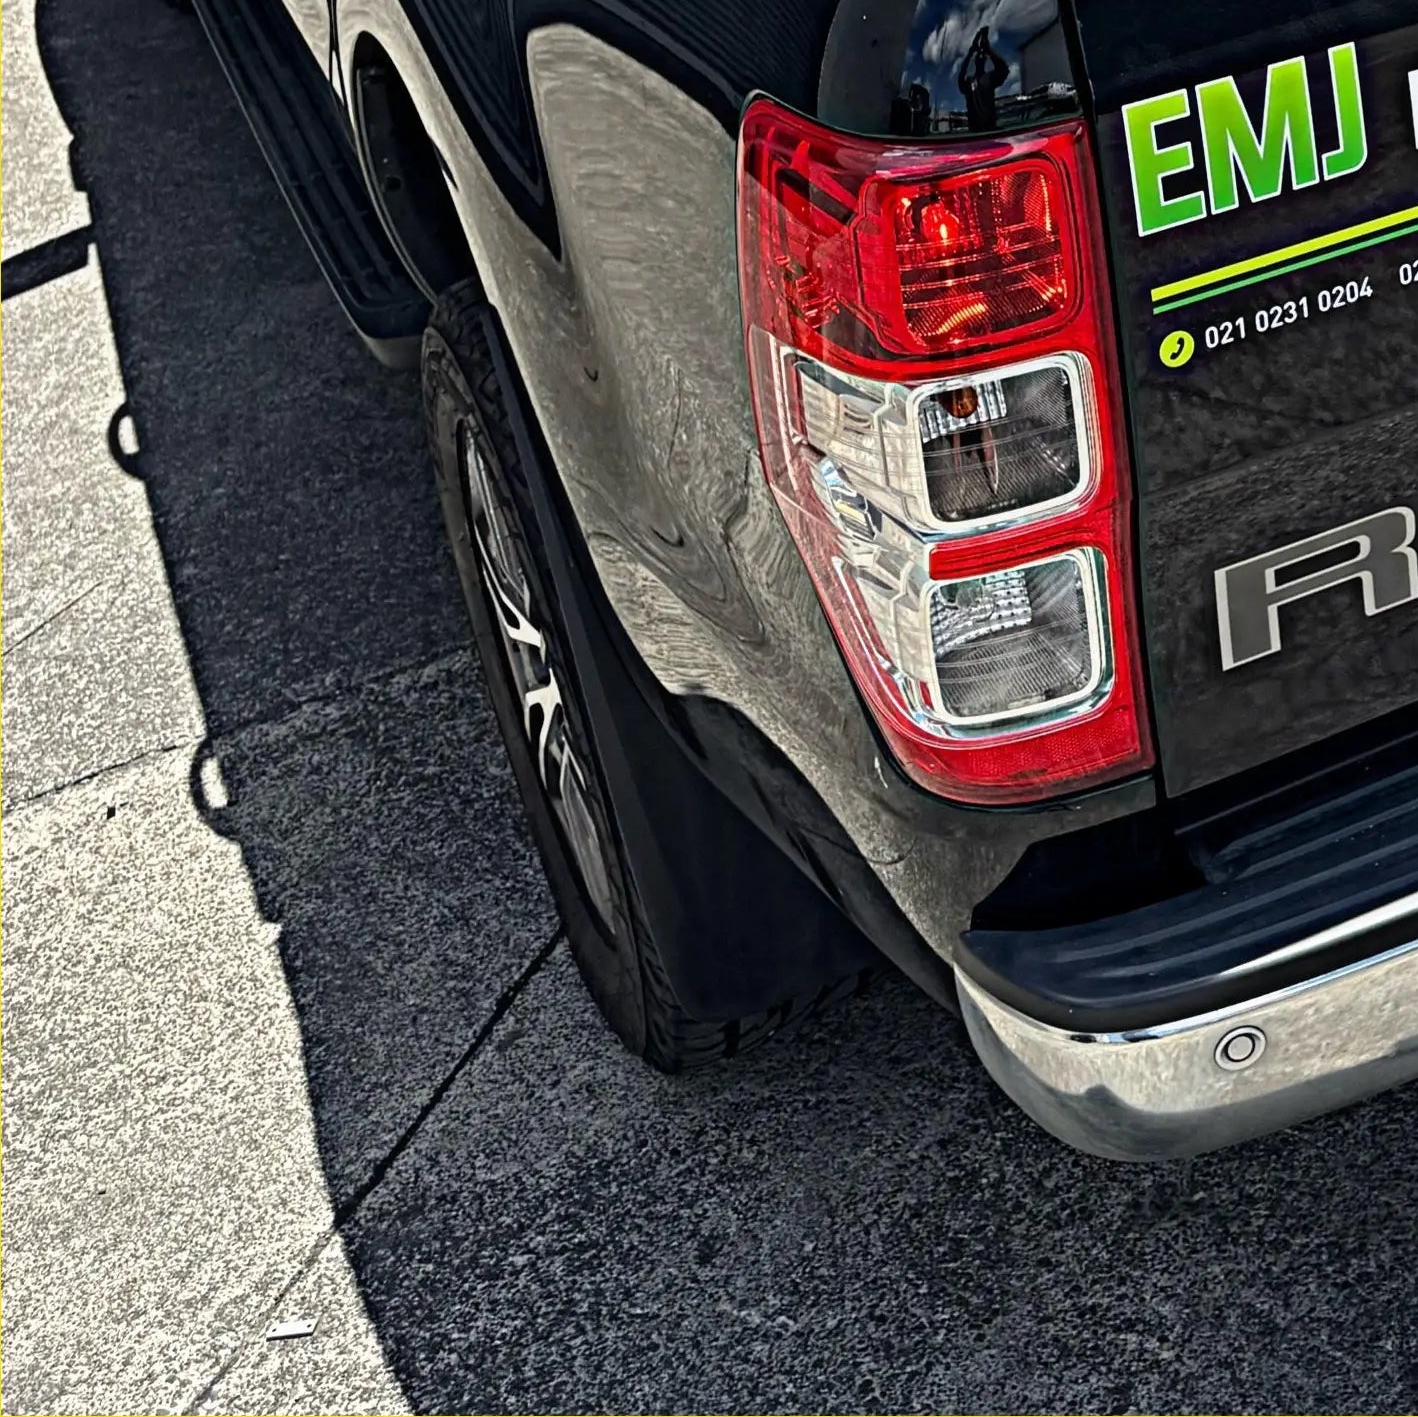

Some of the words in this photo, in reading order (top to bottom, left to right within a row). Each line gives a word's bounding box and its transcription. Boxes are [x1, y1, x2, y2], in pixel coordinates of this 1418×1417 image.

[1121, 41, 1369, 237] EMJ
[1204, 316, 1247, 349] 021
[1255, 297, 1309, 333] 0231
[1317, 275, 1374, 313] 0204
